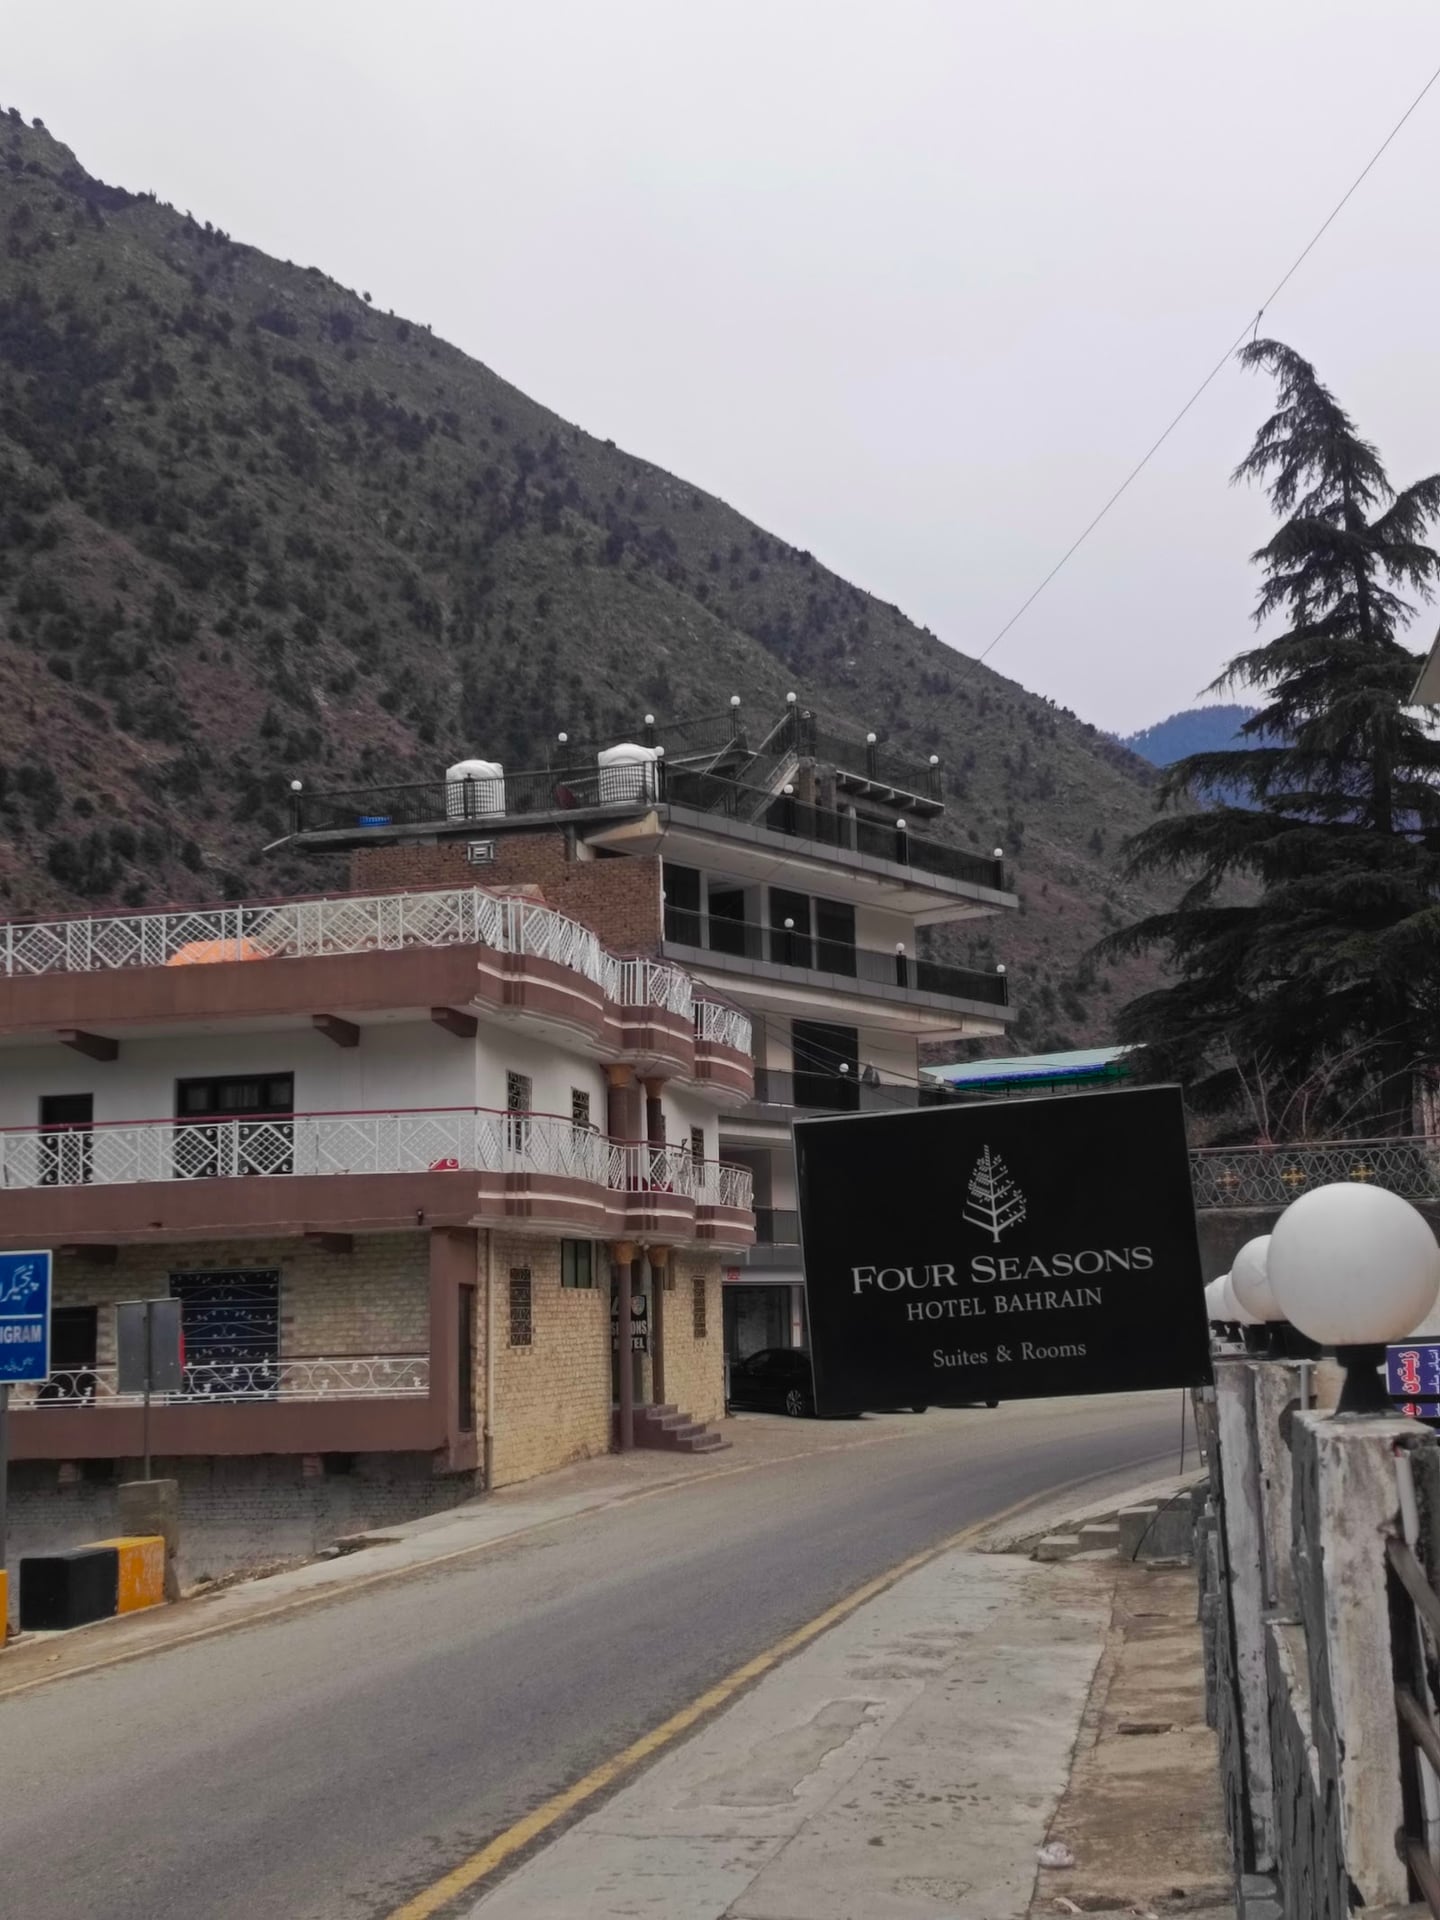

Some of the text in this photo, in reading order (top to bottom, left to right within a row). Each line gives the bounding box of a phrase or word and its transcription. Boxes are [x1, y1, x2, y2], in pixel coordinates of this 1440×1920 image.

[851, 1246, 1154, 1294] FOUR SEASONS
[906, 1287, 1103, 1321] HOTEL BAHRAIN
[933, 1342, 1087, 1368] Suites & Rooms
